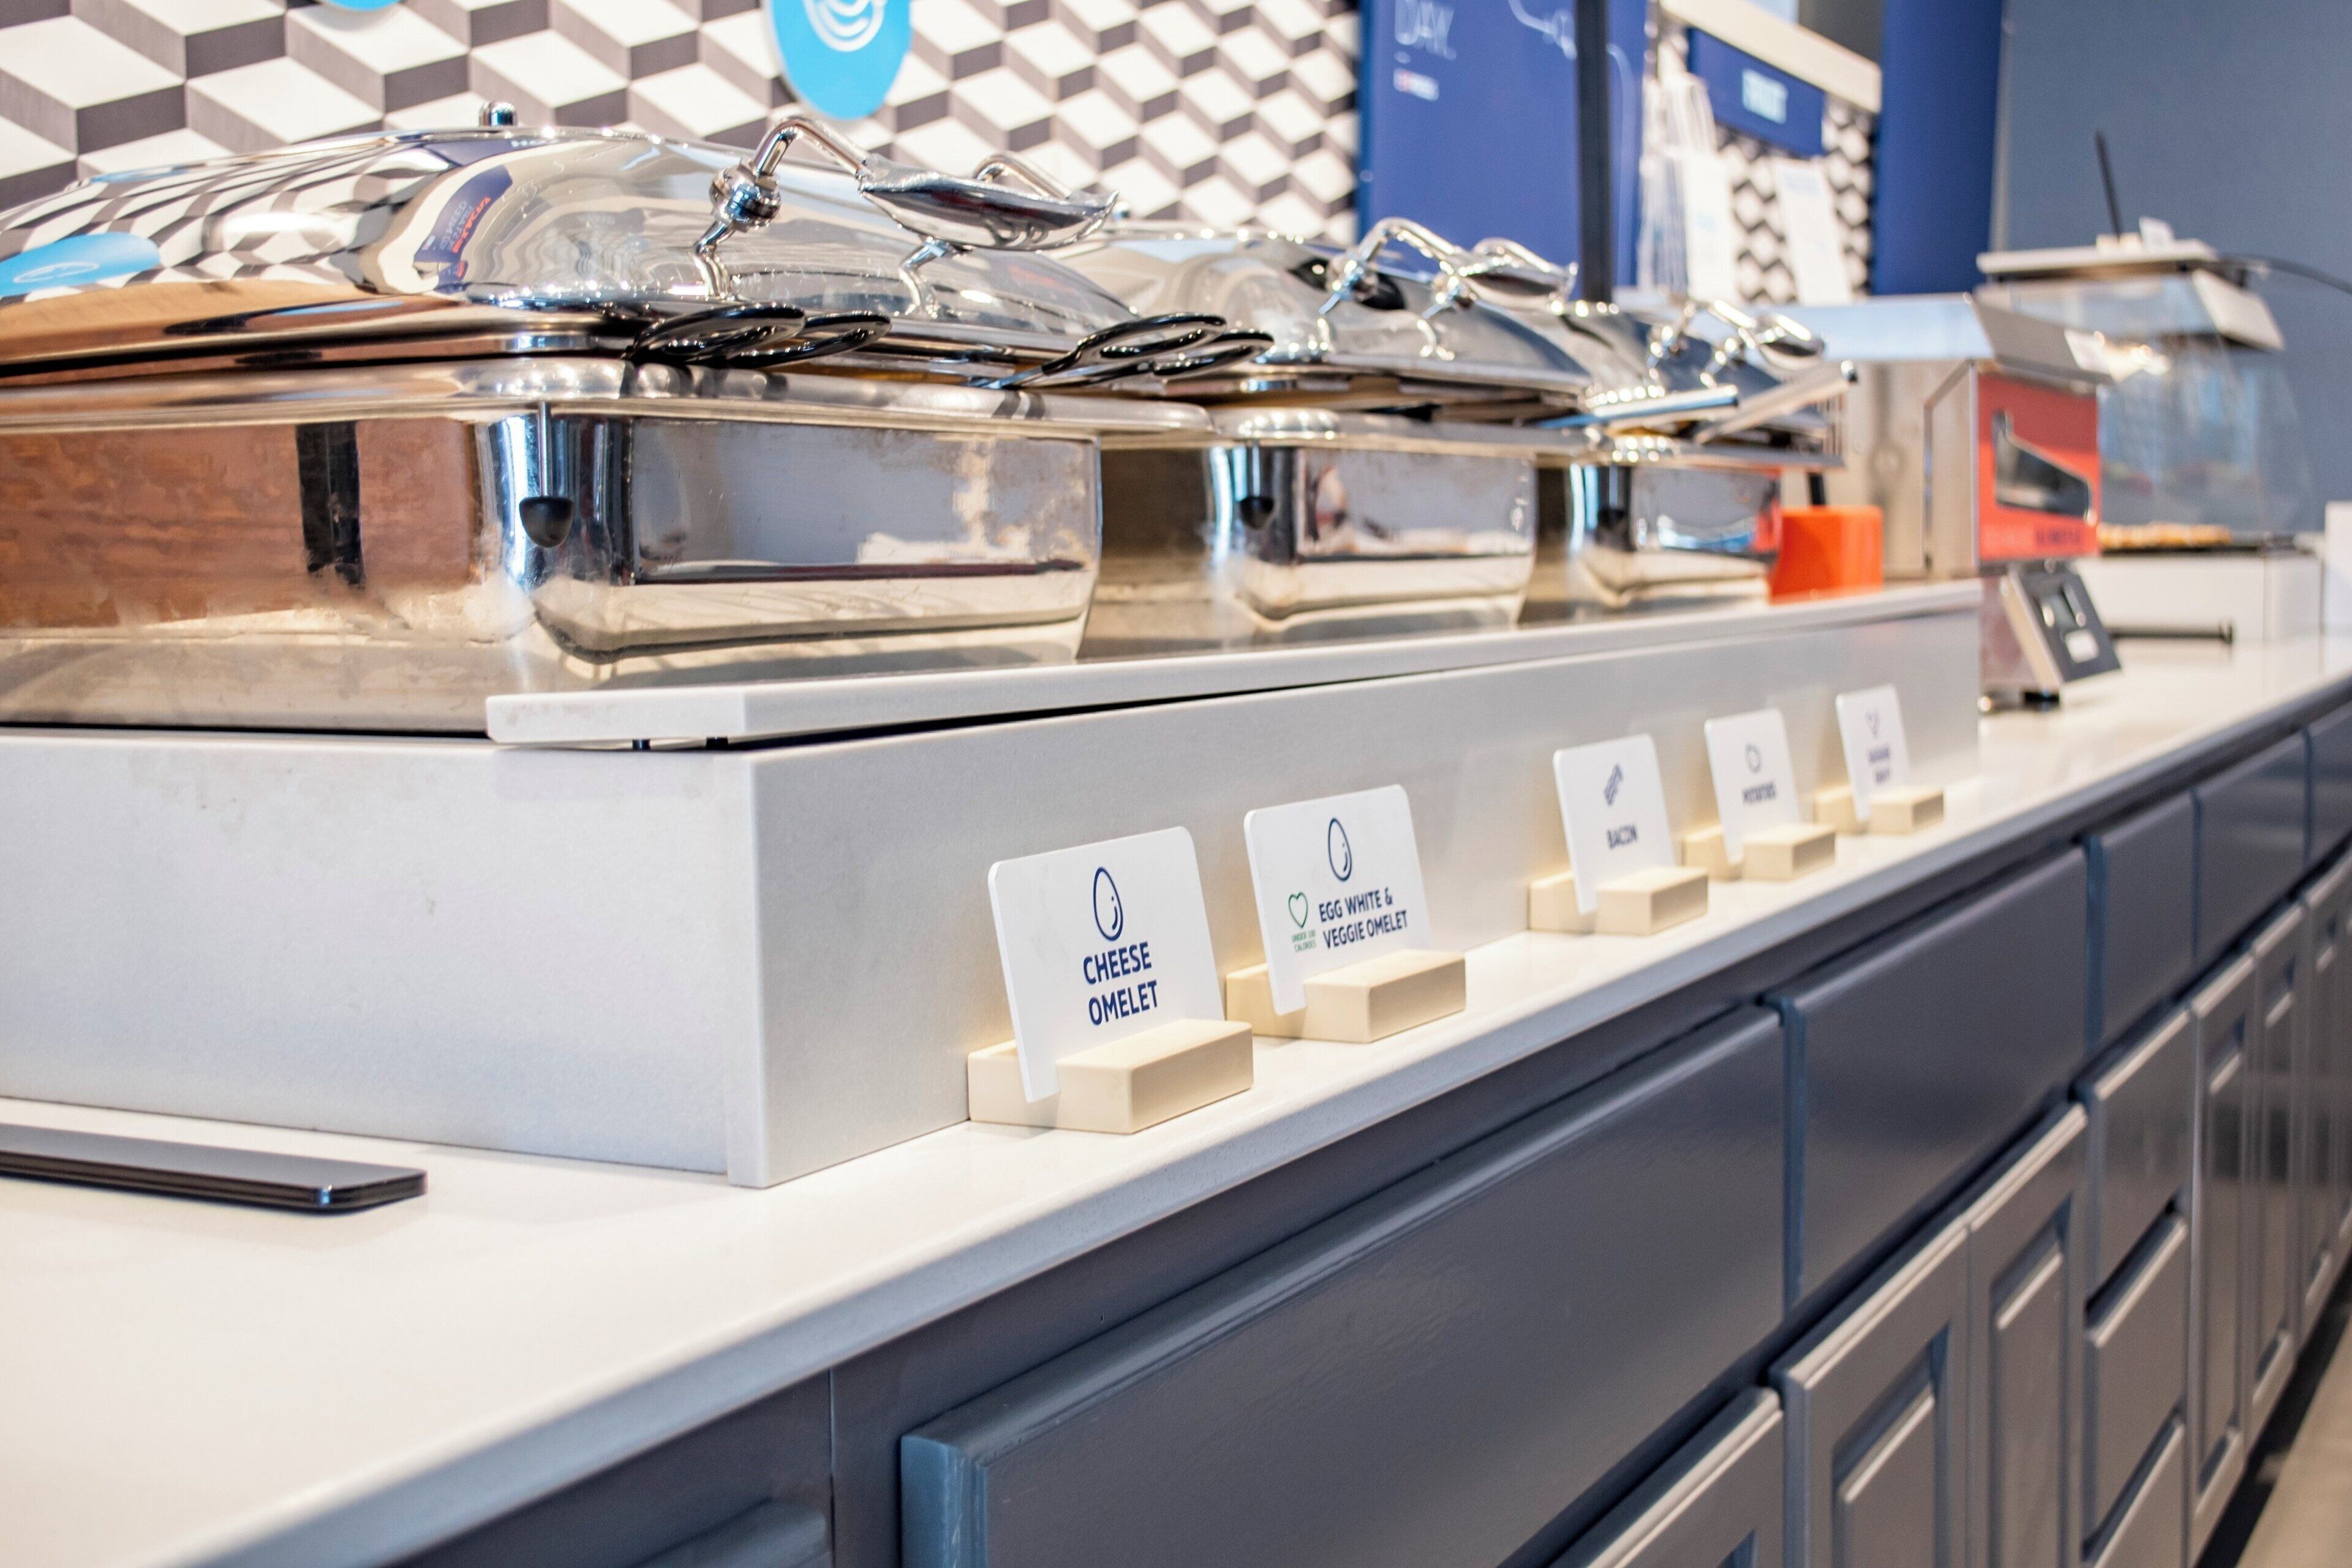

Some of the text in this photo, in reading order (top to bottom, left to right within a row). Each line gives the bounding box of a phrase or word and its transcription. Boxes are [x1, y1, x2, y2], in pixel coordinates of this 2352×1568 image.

[1606, 824, 1637, 850] BACON
[1319, 887, 1393, 923] EGG WHITE &
[1323, 910, 1408, 949] VEGGIE OMELET
[1083, 941, 1152, 985] CHEESE
[1088, 979, 1158, 1025] OMELET
